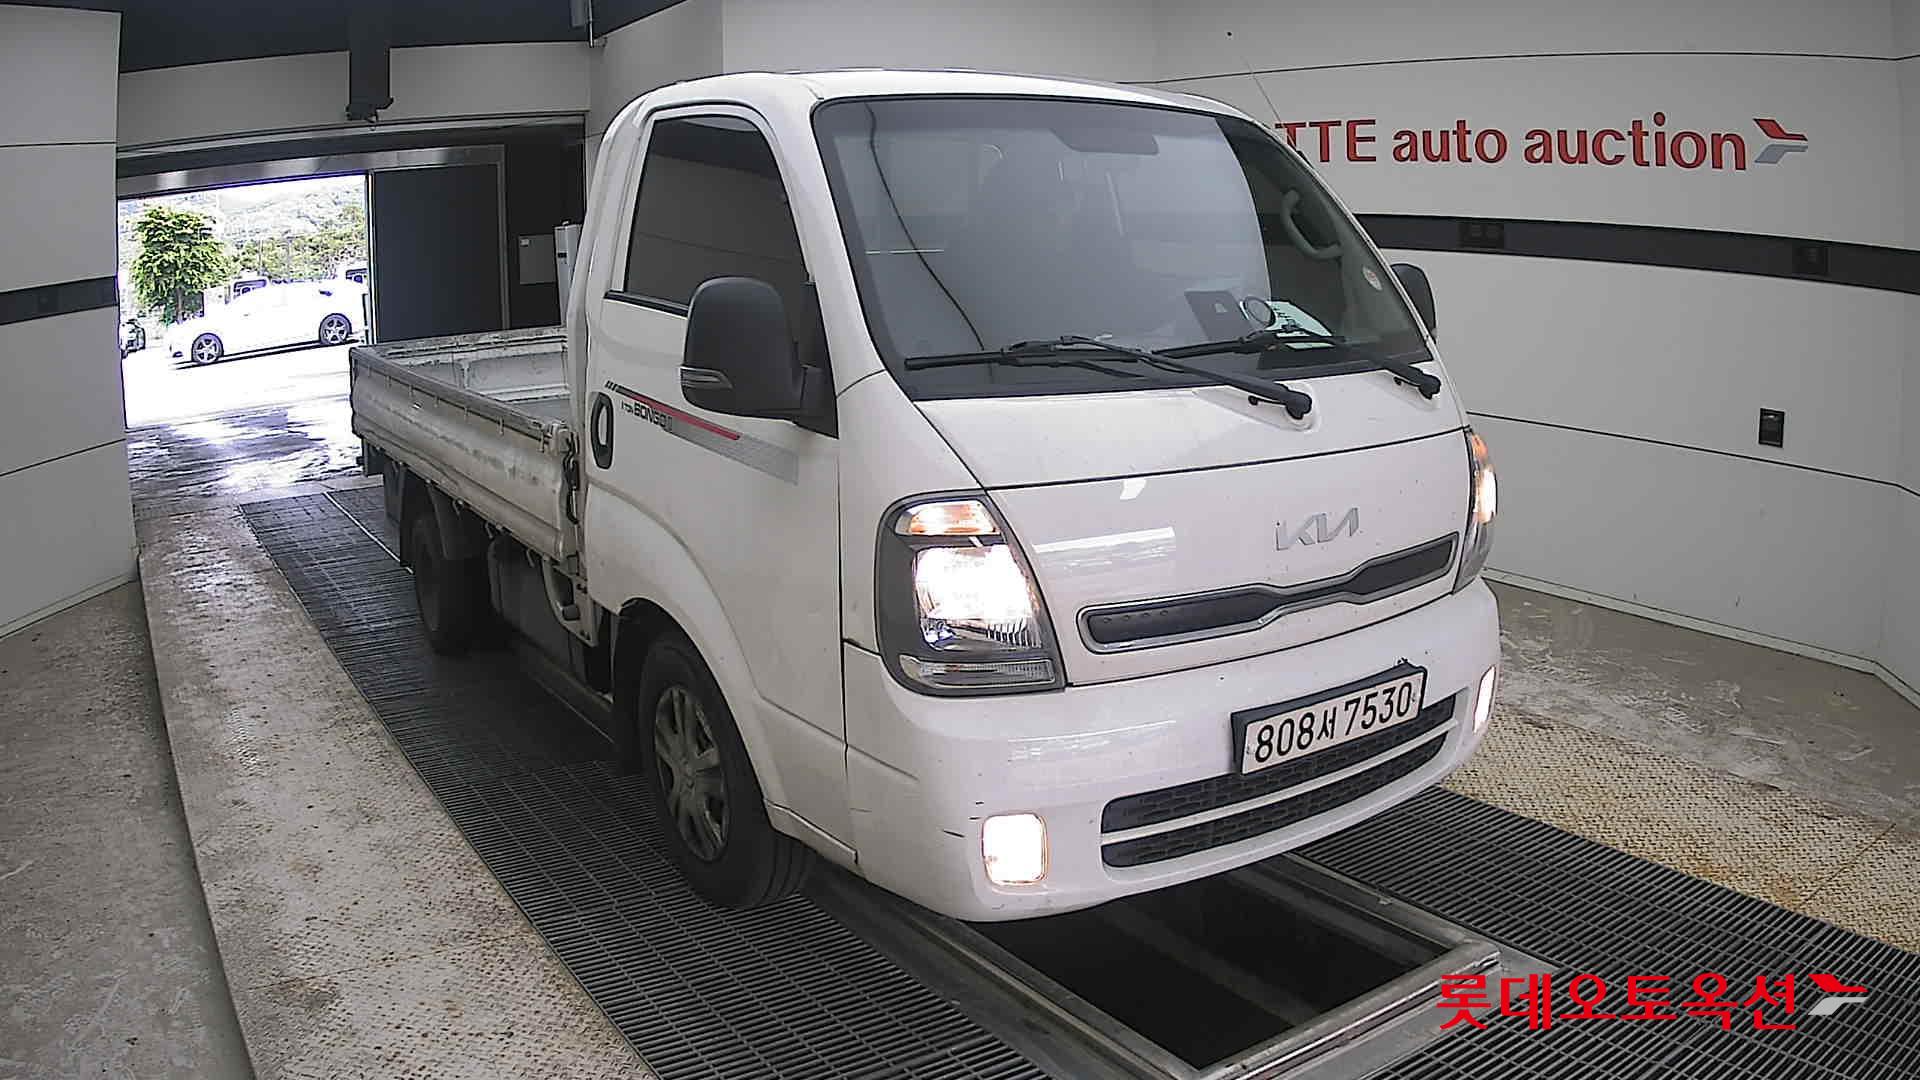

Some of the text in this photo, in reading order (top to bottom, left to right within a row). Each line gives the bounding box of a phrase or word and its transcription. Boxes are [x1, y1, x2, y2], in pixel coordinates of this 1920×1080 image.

[1392, 119, 1508, 164] auto
[1523, 111, 1747, 171] auction
[1275, 507, 1360, 551] KIA
[1254, 681, 1413, 763] 808서 7530
